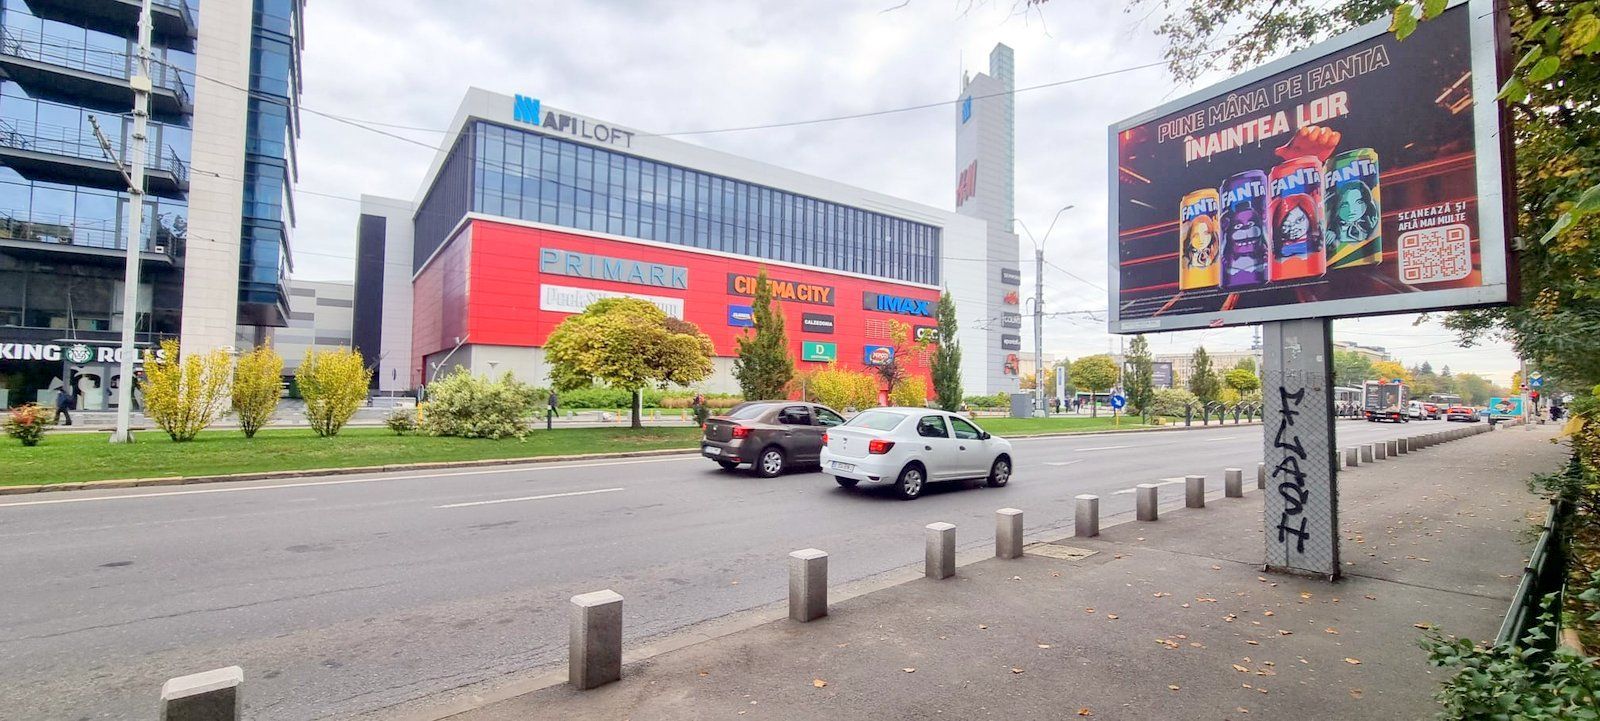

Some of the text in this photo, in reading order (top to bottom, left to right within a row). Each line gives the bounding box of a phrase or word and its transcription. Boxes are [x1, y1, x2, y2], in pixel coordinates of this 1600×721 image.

[1158, 44, 1390, 143] PUNE MÂNA PE FANTA
[542, 111, 635, 148] AFI LOFT
[1184, 90, 1350, 165] ÎNAINTEA LOR
[1270, 168, 1321, 198] FANTA
[1325, 159, 1377, 189] FANTA
[1221, 181, 1266, 209] FANTA
[1182, 198, 1218, 222] FANTA
[1398, 201, 1466, 221] SCANEAZĂ ȘI
[1398, 212, 1466, 231] AFLĂ MAI MULTE
[541, 250, 686, 288] PRIMARK
[797, 284, 830, 303] CITY
[877, 294, 929, 316] IMAX
[0, 343, 61, 361] KING
[815, 344, 825, 355] D
